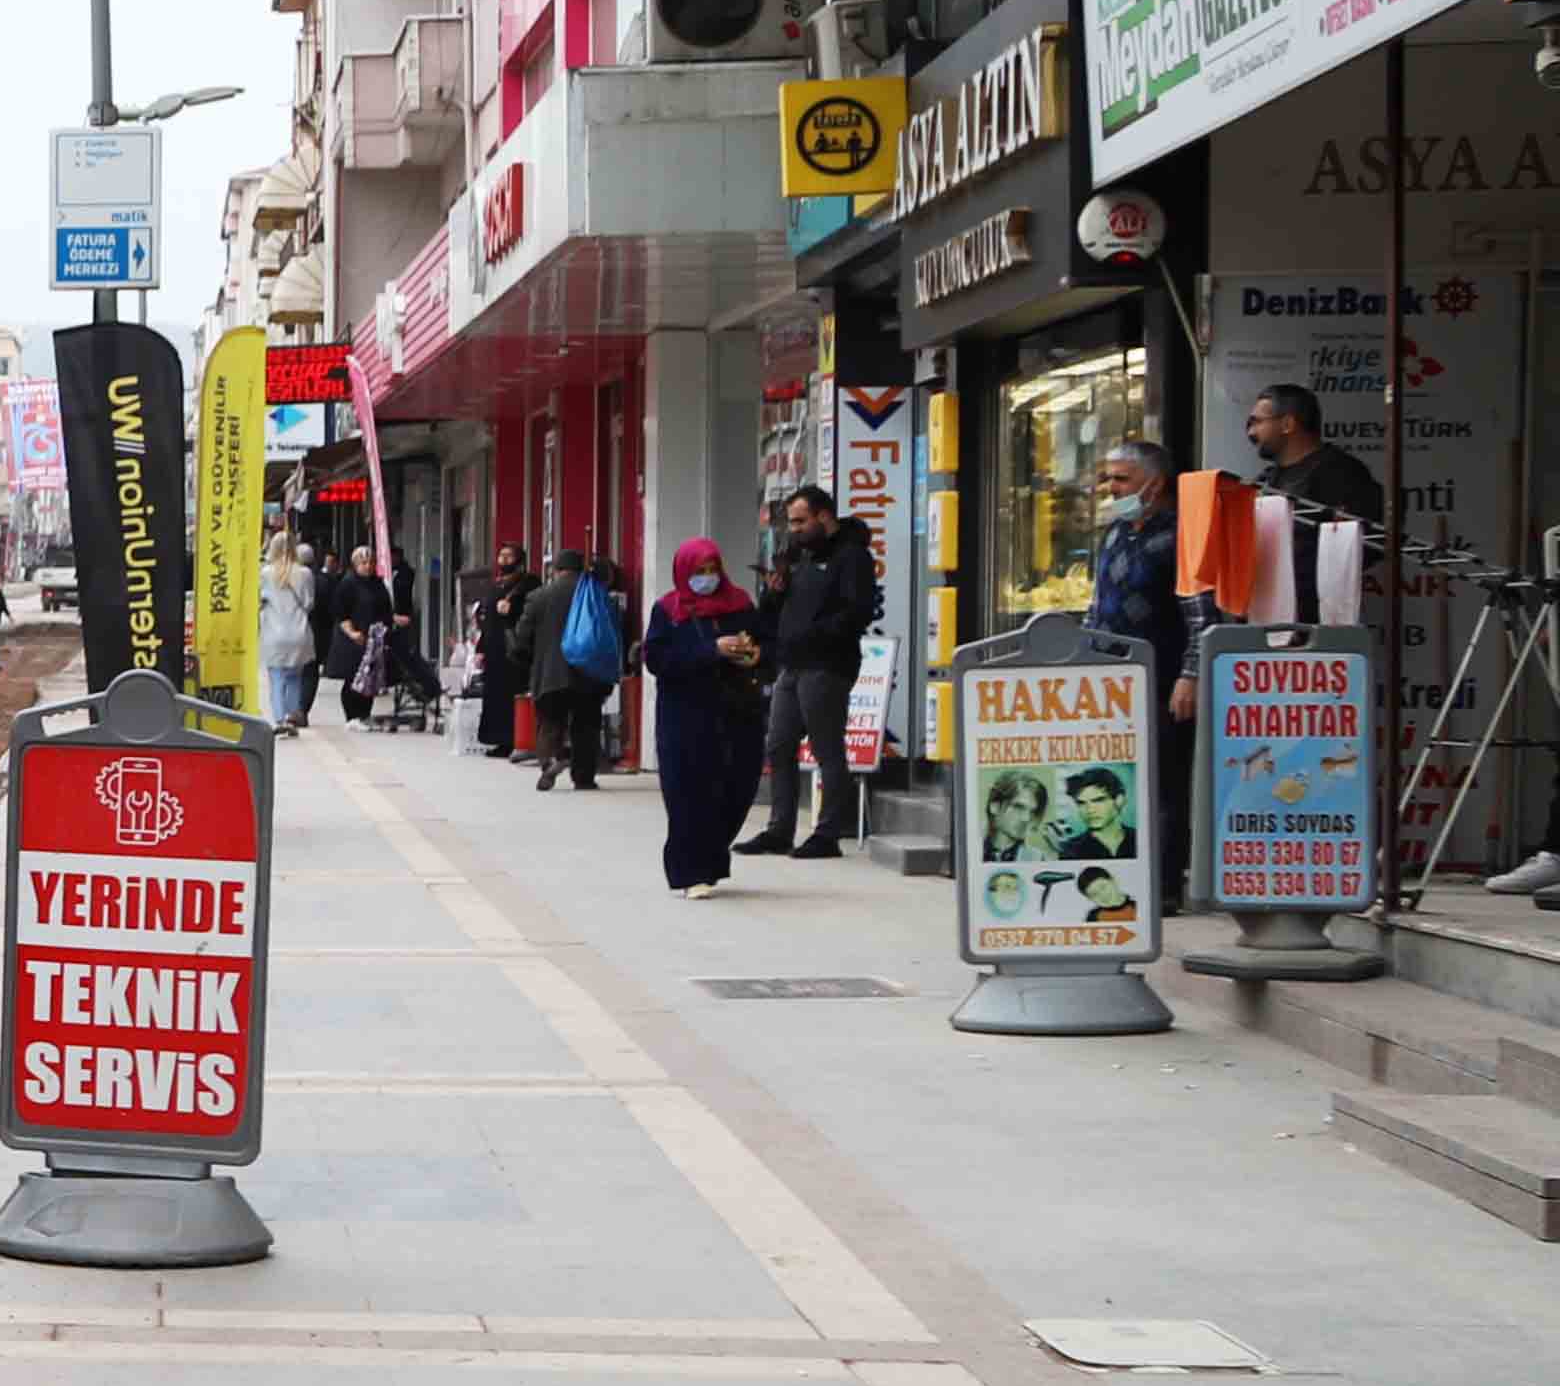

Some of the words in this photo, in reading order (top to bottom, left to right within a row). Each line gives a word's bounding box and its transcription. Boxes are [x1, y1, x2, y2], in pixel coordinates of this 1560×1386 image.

[891, 101, 948, 222] ASYA
[950, 25, 1043, 186] ALTIN
[67, 233, 117, 246] FATURA
[1242, 286, 1425, 317] DenizBak
[1323, 421, 1385, 439] UVEY
[1233, 661, 1348, 699] SOYDAŞ
[976, 676, 1135, 723] HAKAN
[1224, 704, 1359, 737] ANAHTAR
[977, 736, 1043, 764] ERKEK
[1223, 841, 1266, 866] 0533
[1272, 841, 1305, 866] 334
[1273, 871, 1306, 897] 334
[29, 870, 245, 936] YERİNDE
[26, 960, 240, 1033] TEKNİK
[24, 1041, 236, 1117] SERVİS
